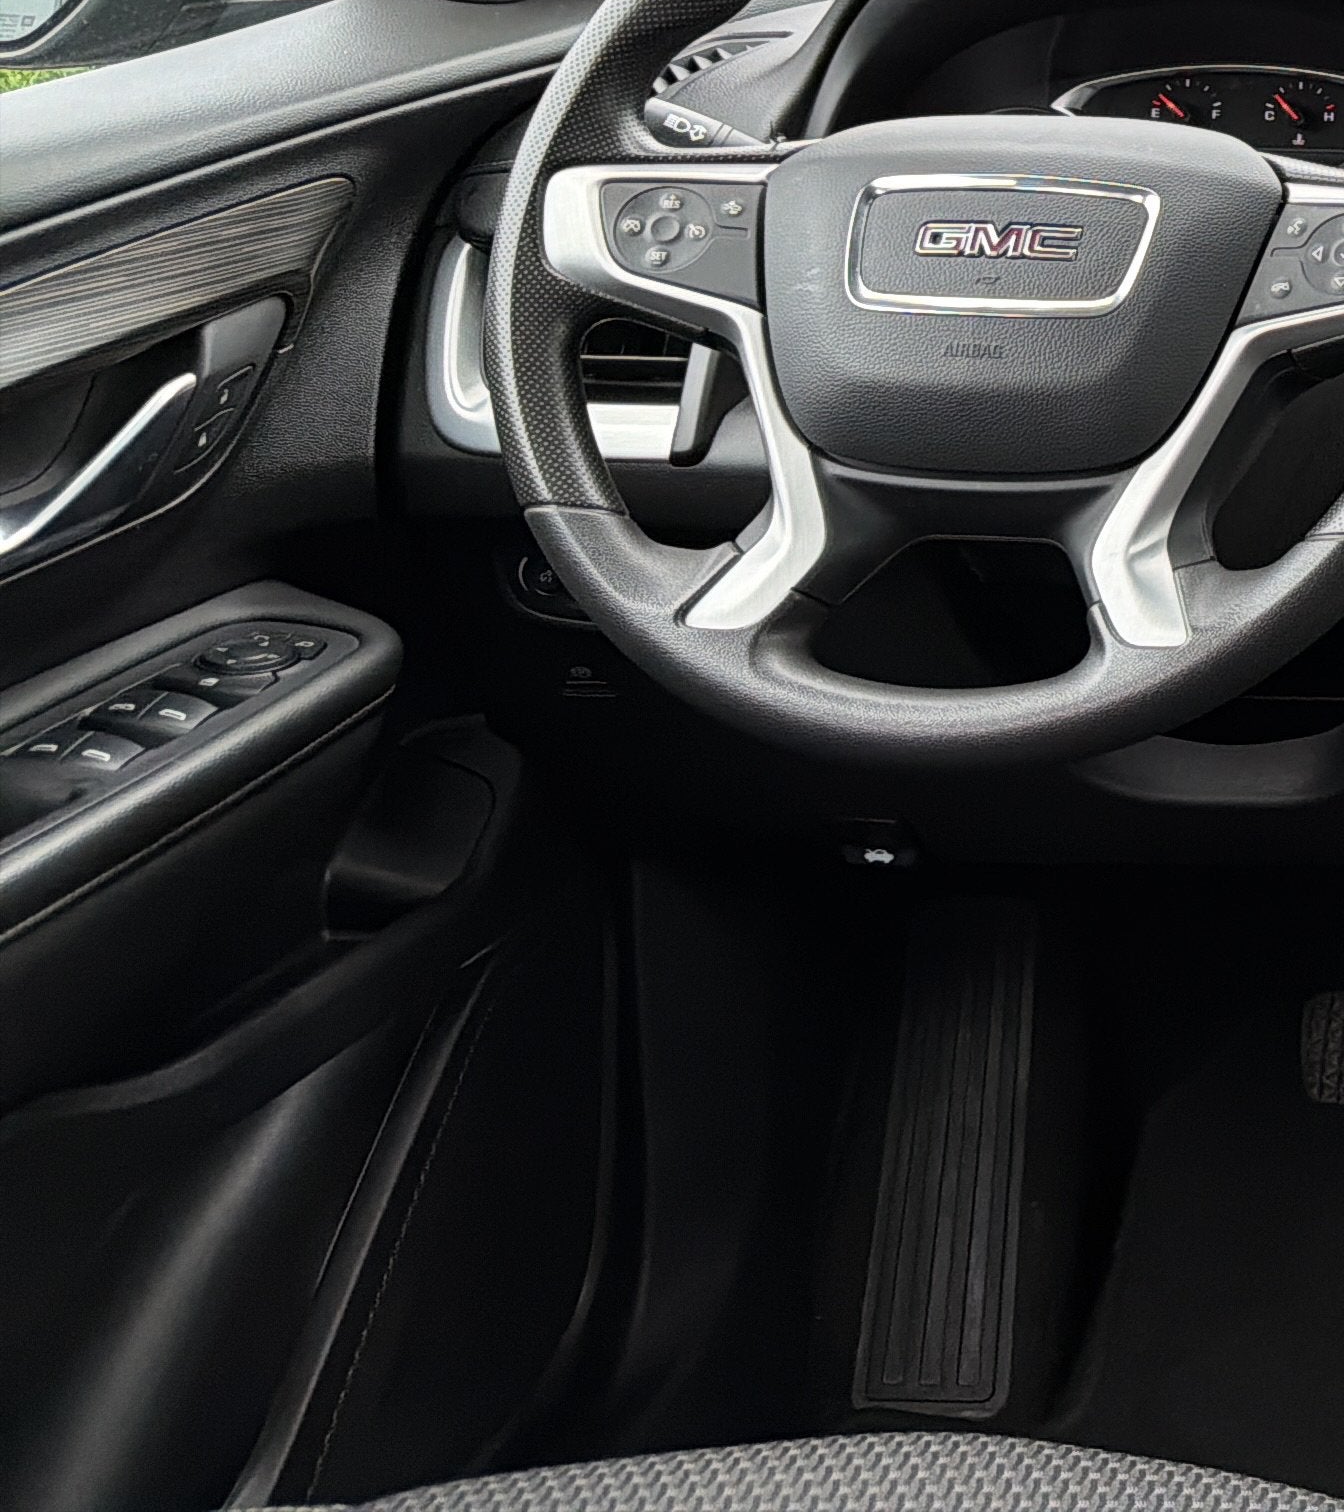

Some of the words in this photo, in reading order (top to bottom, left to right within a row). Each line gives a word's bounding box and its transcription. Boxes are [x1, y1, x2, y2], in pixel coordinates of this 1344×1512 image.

[1151, 107, 1161, 119] E
[1211, 108, 1221, 120] F
[1265, 110, 1276, 121] C
[1324, 111, 1334, 122] H
[663, 200, 681, 209] RES
[914, 219, 1084, 262] GMC
[650, 251, 668, 261] SET
[943, 342, 1004, 360] AIRBAG
